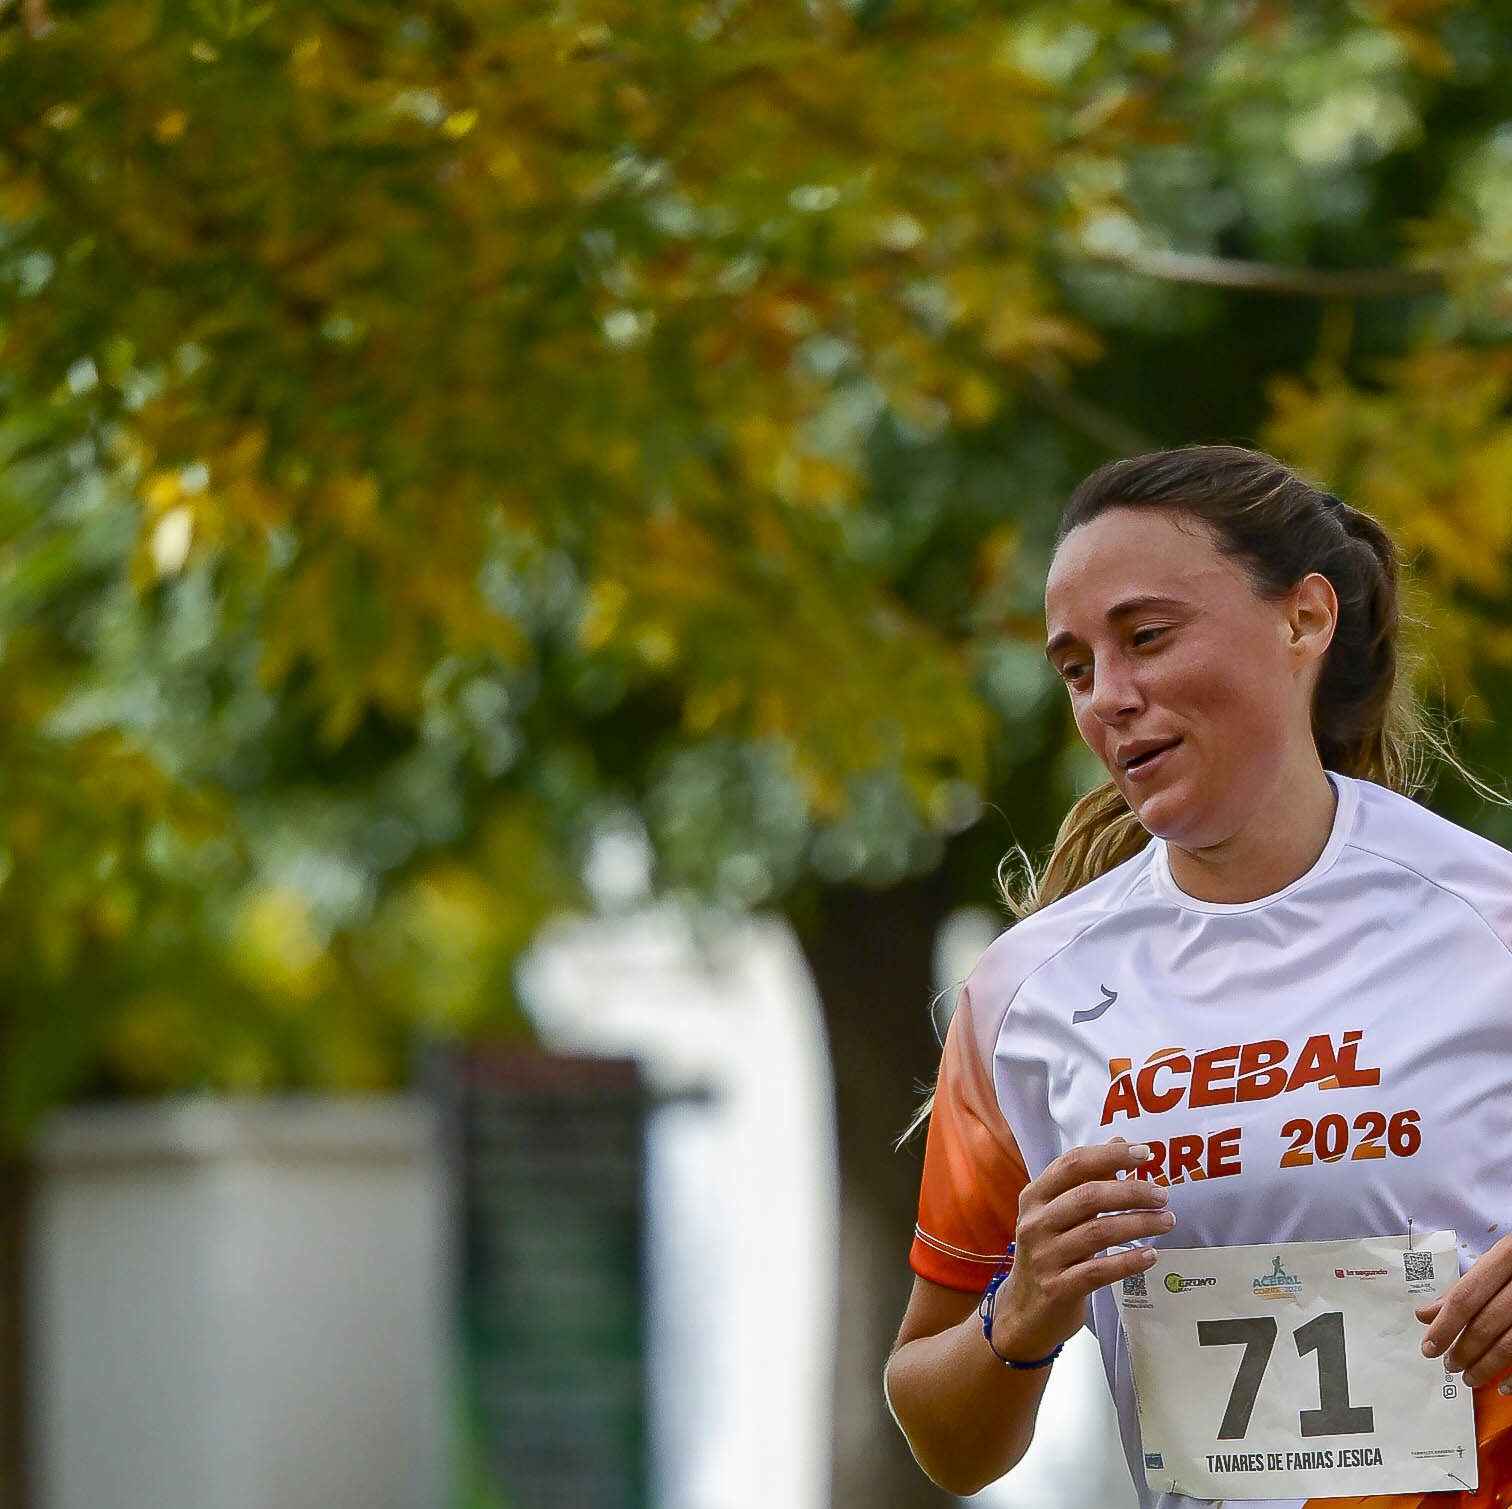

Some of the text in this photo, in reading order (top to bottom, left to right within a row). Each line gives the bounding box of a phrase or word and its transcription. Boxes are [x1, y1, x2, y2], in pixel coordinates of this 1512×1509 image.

[1099, 1030, 1381, 1126] ACEBAL
[1116, 1109, 1422, 1187] RRE 2026
[1197, 1311, 1375, 1440] 71
[1206, 1447, 1383, 1473] TAVARES DE FARIAS JESICA
